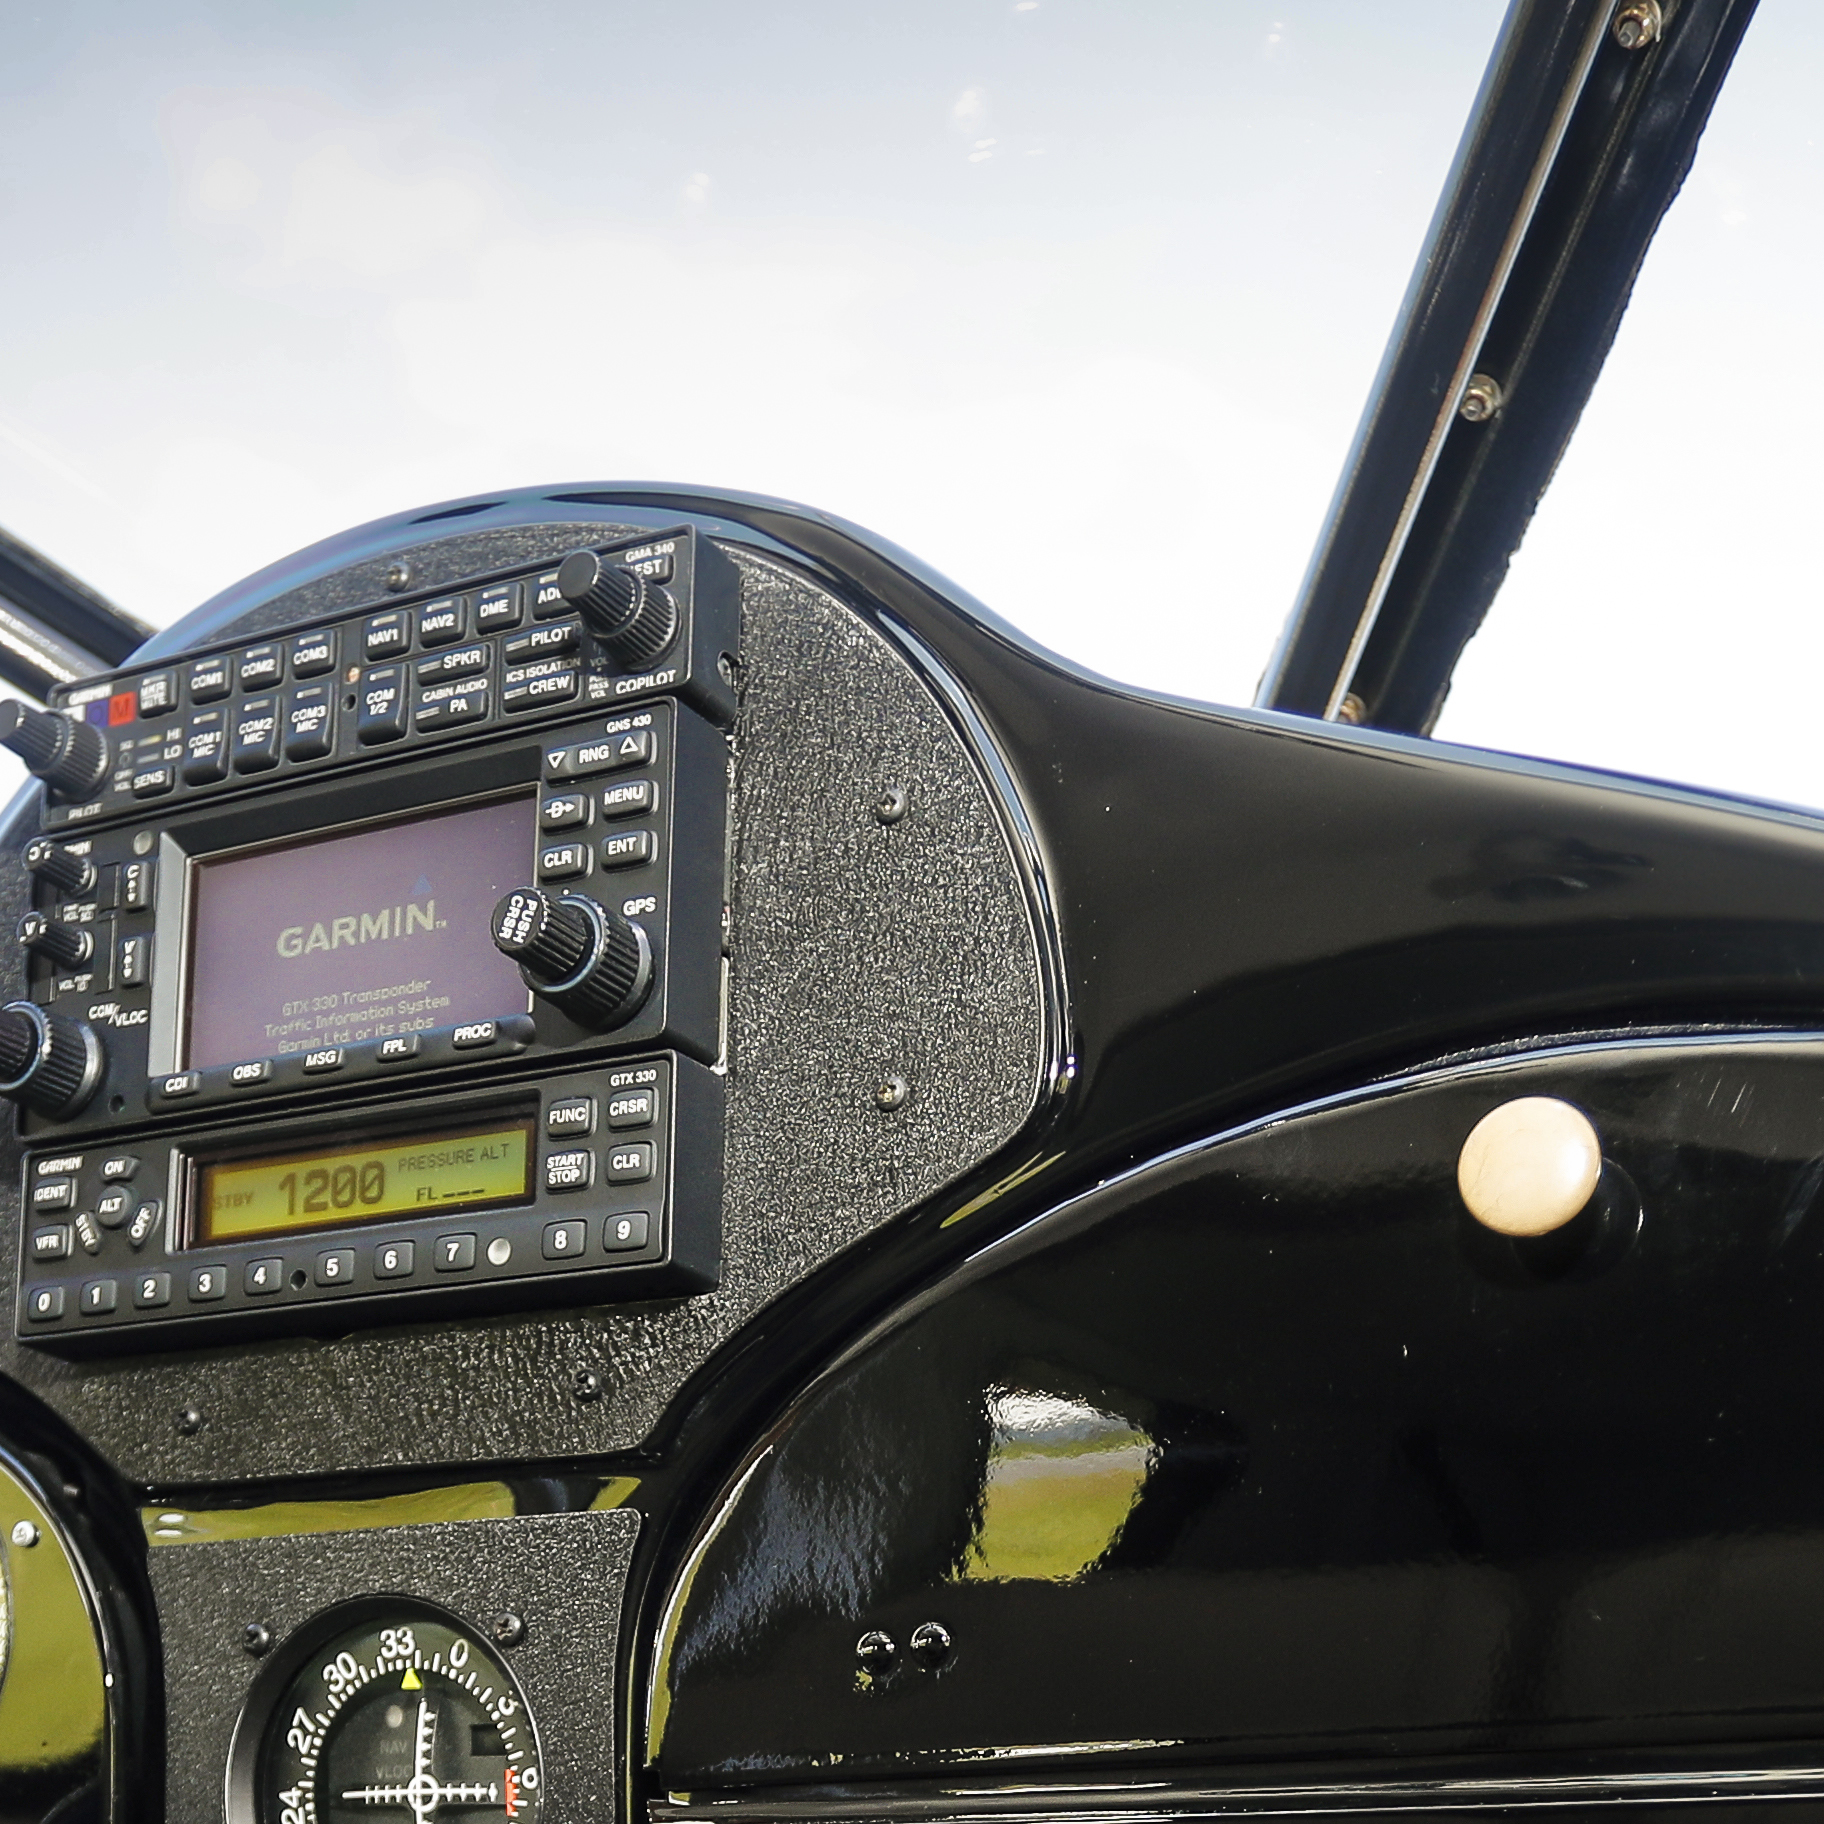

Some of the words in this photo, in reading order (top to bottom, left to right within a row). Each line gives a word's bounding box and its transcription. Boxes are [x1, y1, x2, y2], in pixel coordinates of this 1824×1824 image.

[480, 600, 509, 617] DME
[422, 613, 455, 632] NAV2
[368, 629, 398, 646] NAV1
[531, 626, 571, 646] PILOT
[293, 645, 328, 664] COM3
[443, 650, 481, 669] SPKR
[241, 658, 275, 677] COM2
[191, 672, 223, 690] COM1
[422, 685, 454, 703] CABIN
[455, 678, 488, 695] AUDIO
[529, 676, 570, 695] CREW
[616, 669, 676, 694] COPILOT
[366, 688, 395, 704] COM
[291, 705, 326, 722] COM3
[449, 699, 468, 713] PA
[239, 718, 273, 734] COM2
[607, 718, 631, 733] GNS
[632, 714, 652, 728] 430
[188, 732, 222, 748] COM1
[579, 745, 609, 764] RNG
[604, 786, 644, 805] MENU
[608, 836, 637, 855] ENT
[544, 850, 573, 868] CLR
[623, 896, 656, 916] GPS
[499, 895, 523, 939] CRSR
[513, 899, 537, 943] PUSH
[277, 900, 435, 958] GARMIN
[282, 1003, 310, 1016] GTX
[342, 980, 431, 1005] Transponder
[265, 1020, 311, 1037] Traffic
[315, 1005, 394, 1029] Information
[397, 996, 450, 1015] System
[454, 1023, 492, 1041] PROC
[383, 1039, 407, 1055] FPL
[305, 1052, 337, 1066] MSG
[233, 1063, 261, 1080] OBS
[610, 1071, 634, 1086] GTX
[636, 1069, 657, 1083] 330
[549, 1107, 586, 1125] FUNC
[609, 1098, 648, 1116] CRSR
[398, 1148, 474, 1172] PRESSURE
[480, 1144, 510, 1160] ALT
[546, 1154, 583, 1169] START
[612, 1153, 640, 1170] CLR
[548, 1168, 580, 1185] STOP
[279, 1161, 385, 1216] 1200
[131, 1208, 151, 1238] OFF
[379, 1628, 415, 1656] 33
